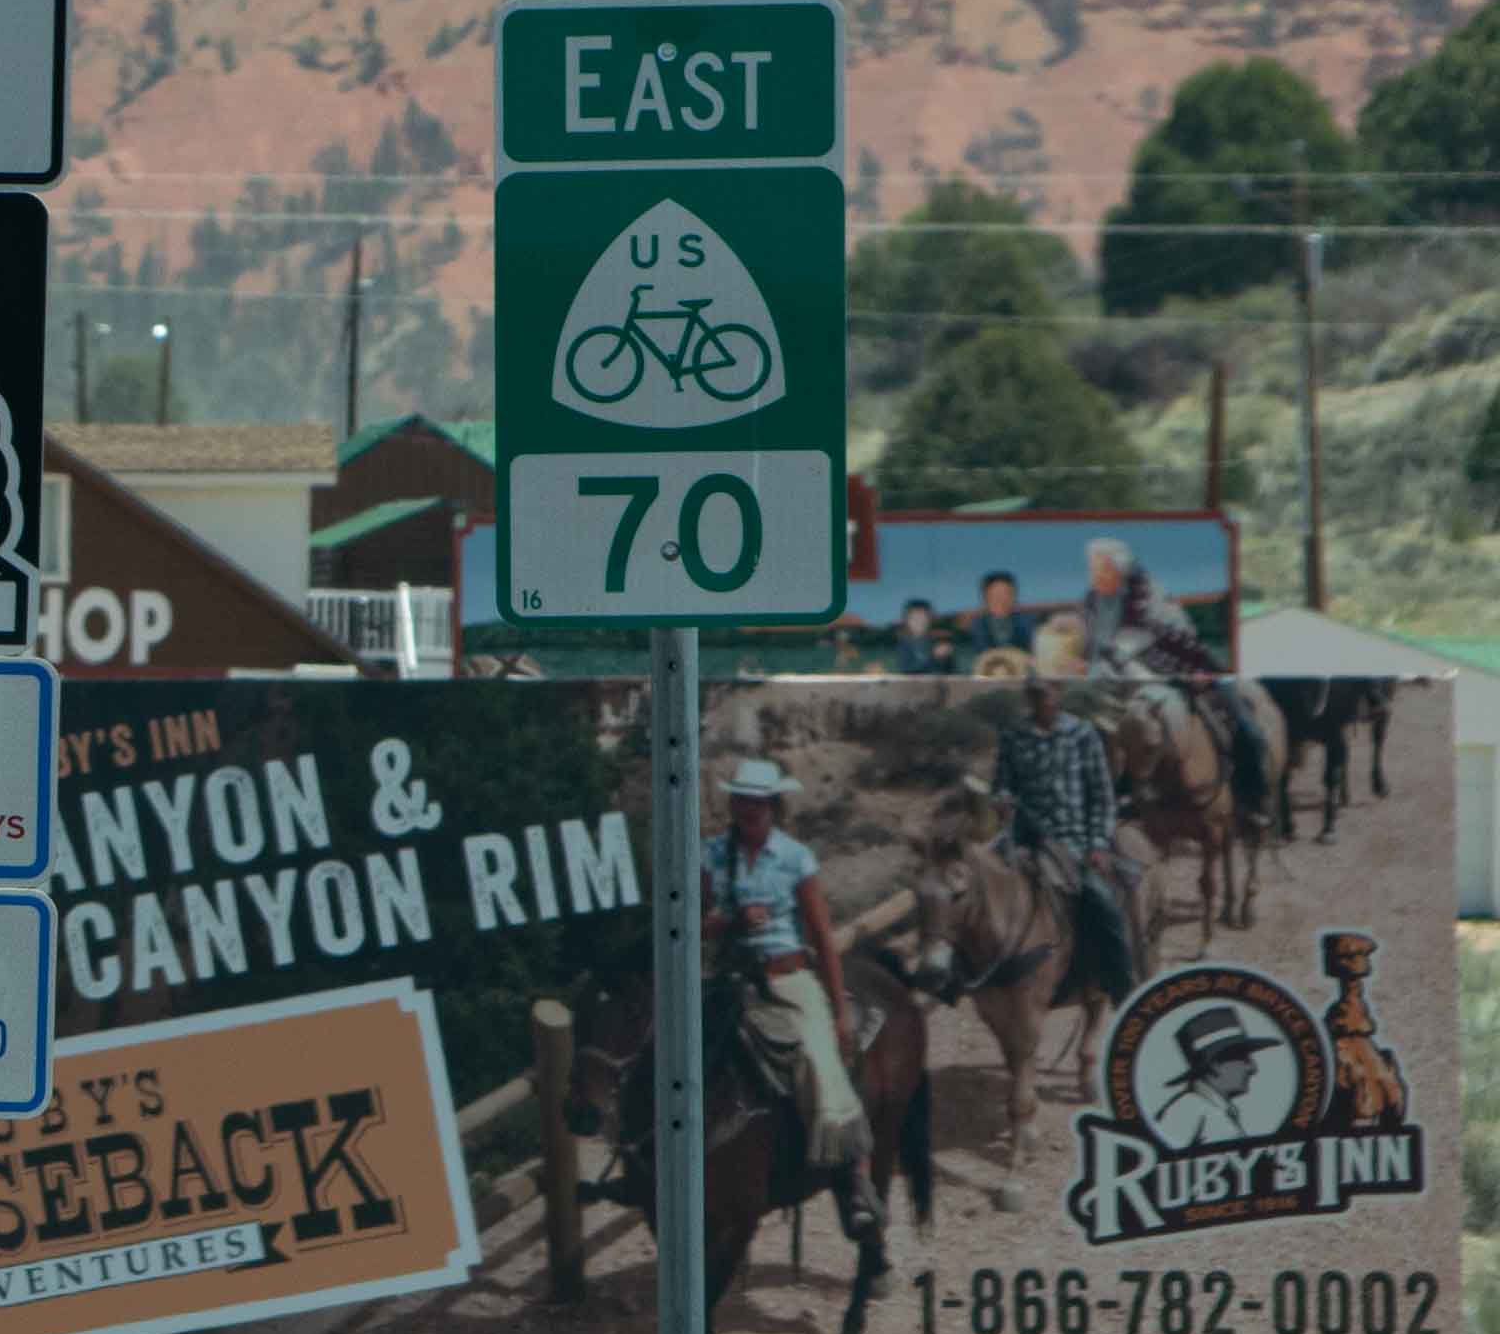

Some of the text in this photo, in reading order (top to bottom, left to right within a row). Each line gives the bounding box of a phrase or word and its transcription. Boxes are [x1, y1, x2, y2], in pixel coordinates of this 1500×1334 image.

[565, 34, 773, 134] EAST
[578, 473, 763, 594] 70
[37, 586, 173, 665] HOP
[521, 589, 543, 610] 16
[147, 709, 221, 762] INN
[50, 738, 443, 893] ANYON &
[64, 810, 642, 1001] CANYON RIM
